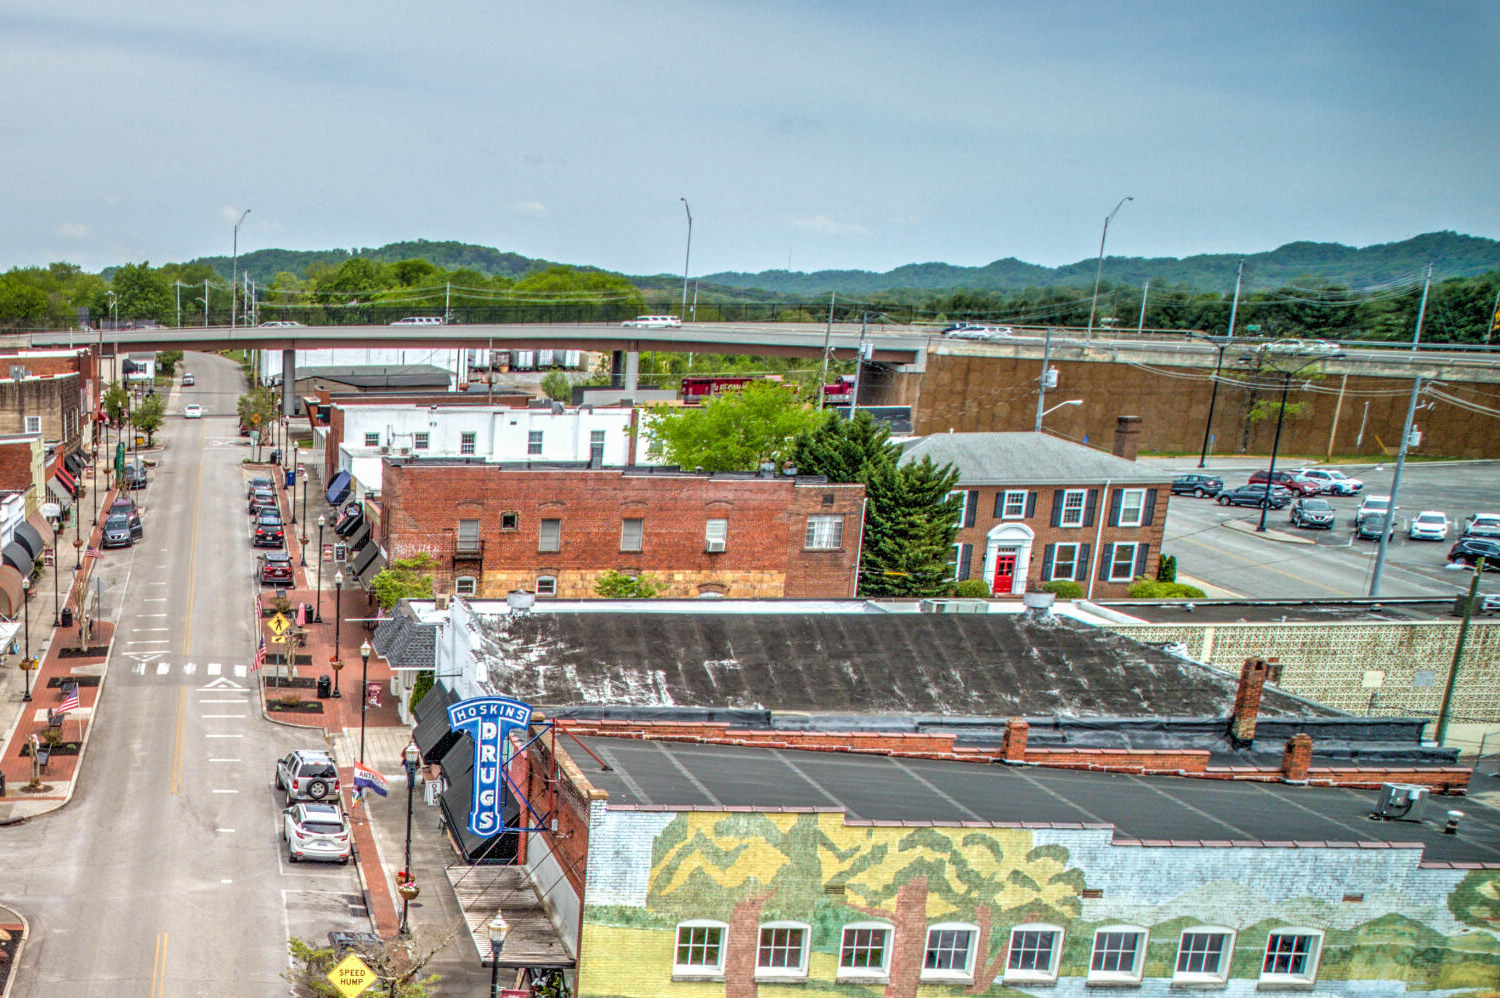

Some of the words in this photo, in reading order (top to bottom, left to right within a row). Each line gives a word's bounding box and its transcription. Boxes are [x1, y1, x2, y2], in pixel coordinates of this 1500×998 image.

[456, 704, 525, 721] HOSKINS
[479, 722, 497, 829] DRUGS
[339, 969, 366, 977] SPEED
[340, 978, 364, 986] HUMP
